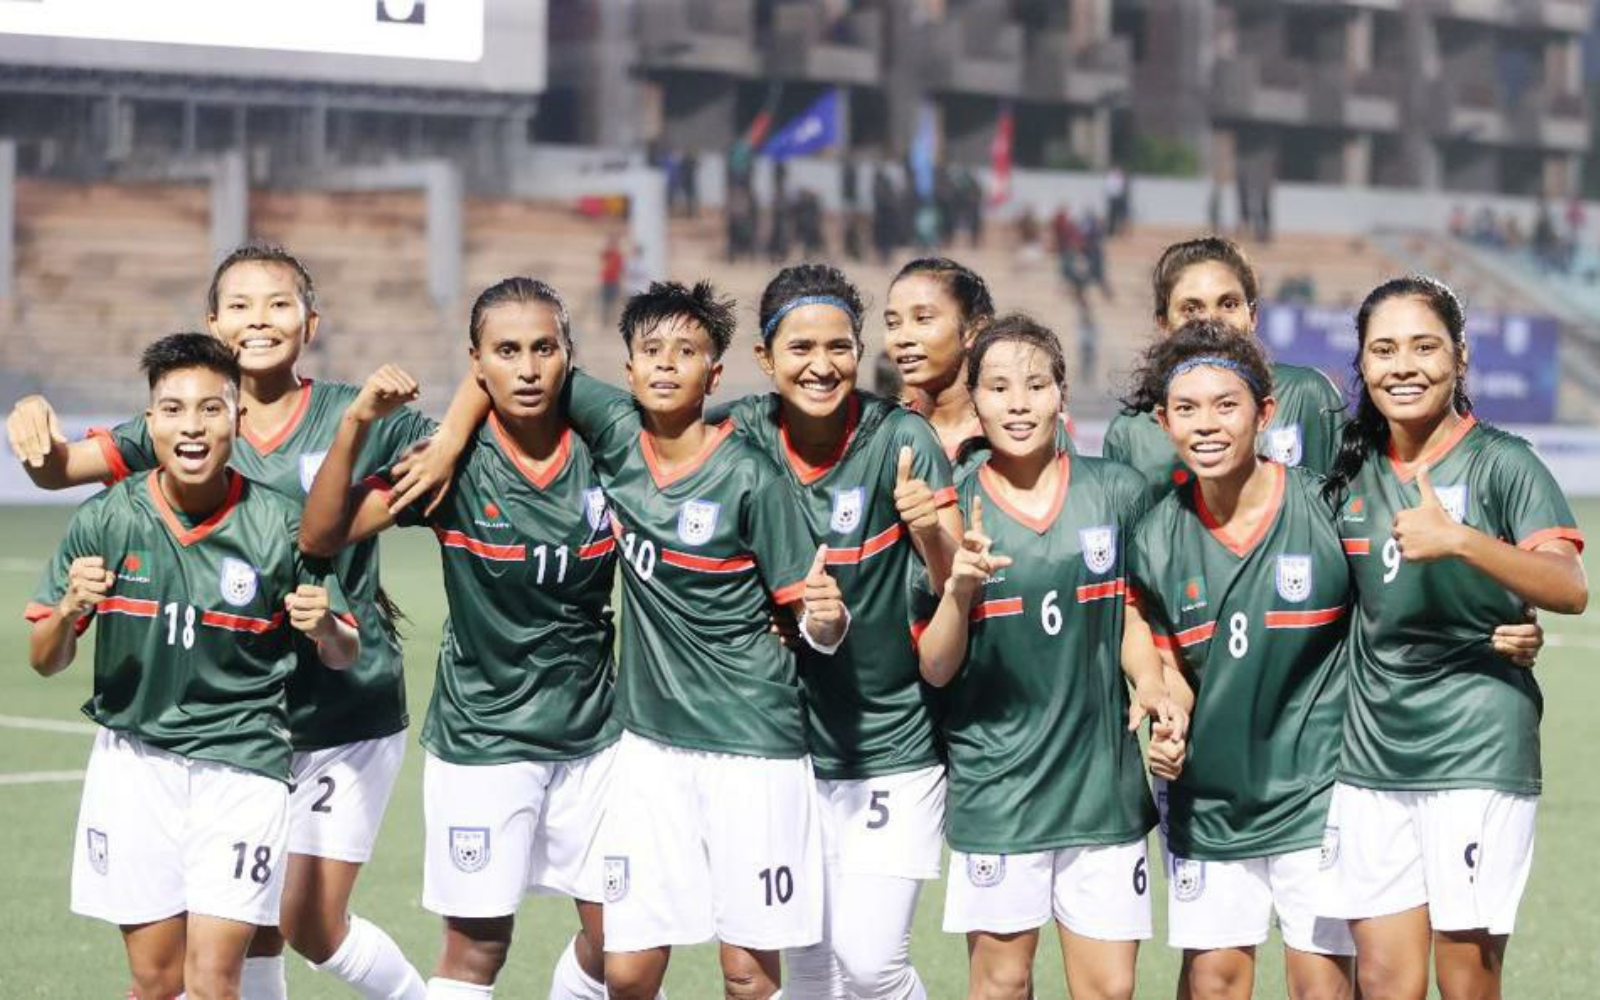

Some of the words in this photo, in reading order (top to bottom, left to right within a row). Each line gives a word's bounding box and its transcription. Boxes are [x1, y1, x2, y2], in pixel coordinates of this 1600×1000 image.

[532, 544, 569, 585] 11
[624, 532, 656, 581] 10
[1381, 538, 1402, 584] 9
[163, 601, 196, 651] 18
[1041, 589, 1063, 636] 6
[1228, 611, 1249, 660] 8
[310, 775, 337, 814] 2
[866, 790, 891, 829] 5
[231, 841, 273, 885] 18
[1132, 856, 1148, 896] 6
[758, 865, 794, 906] 10
